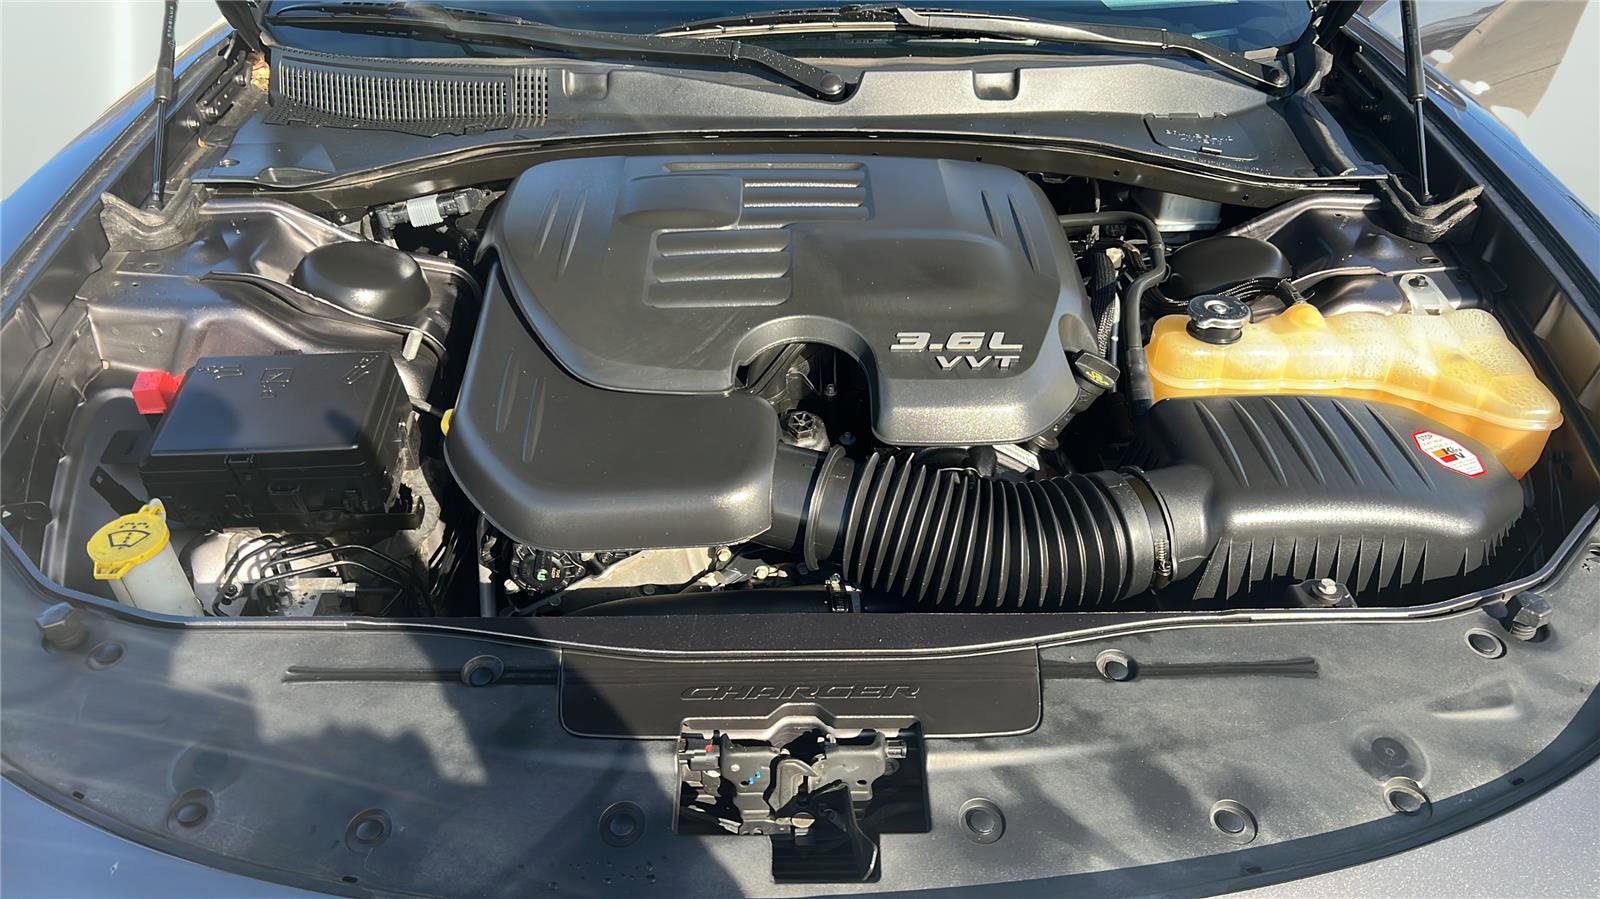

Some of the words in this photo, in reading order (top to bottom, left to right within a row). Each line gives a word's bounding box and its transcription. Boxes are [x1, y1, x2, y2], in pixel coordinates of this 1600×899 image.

[889, 331, 1024, 353] 3.6L
[935, 355, 1021, 371] VVT
[680, 684, 921, 701] CHARGER
